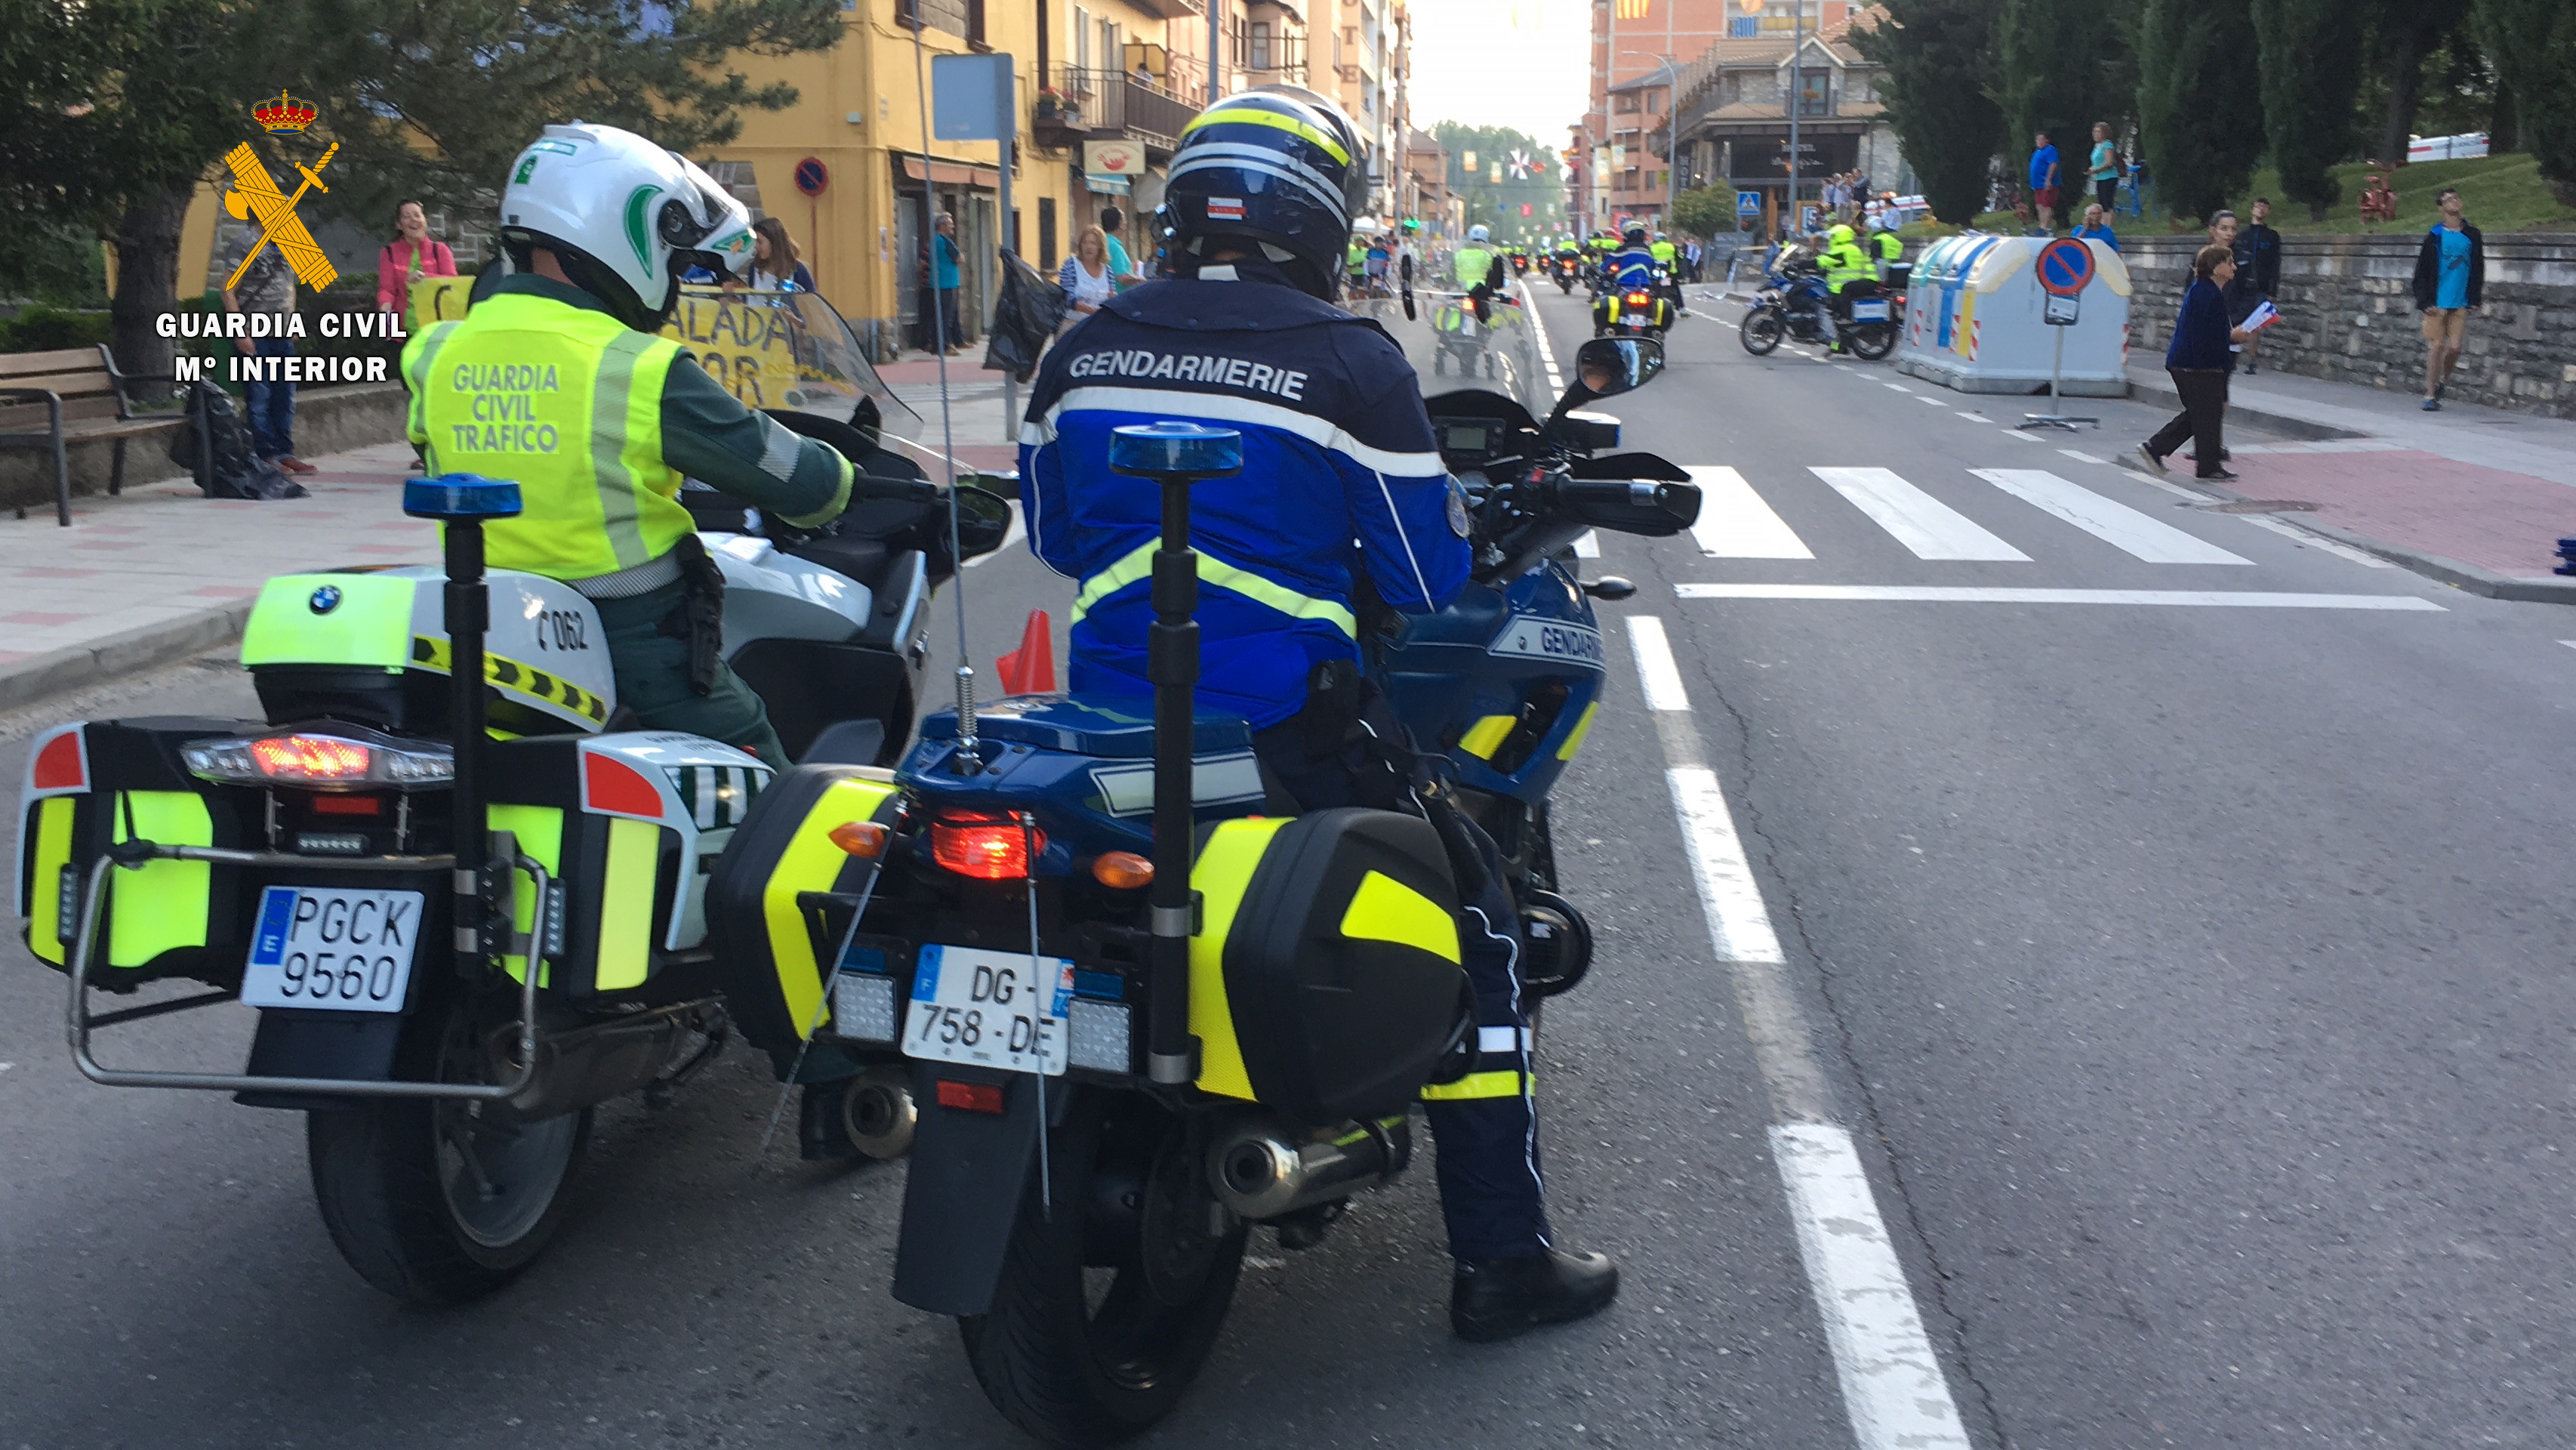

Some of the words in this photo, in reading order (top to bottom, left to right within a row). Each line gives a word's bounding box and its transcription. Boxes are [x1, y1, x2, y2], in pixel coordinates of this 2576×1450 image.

[454, 364, 559, 392] GUARDIA
[1068, 350, 1308, 402] GENDARMERIE
[473, 394, 536, 421] CIVIL
[452, 424, 559, 452] TRAFICO
[552, 610, 589, 651] 062
[291, 896, 412, 946] PGCK
[262, 934, 280, 953] E
[279, 952, 396, 1001] 9560
